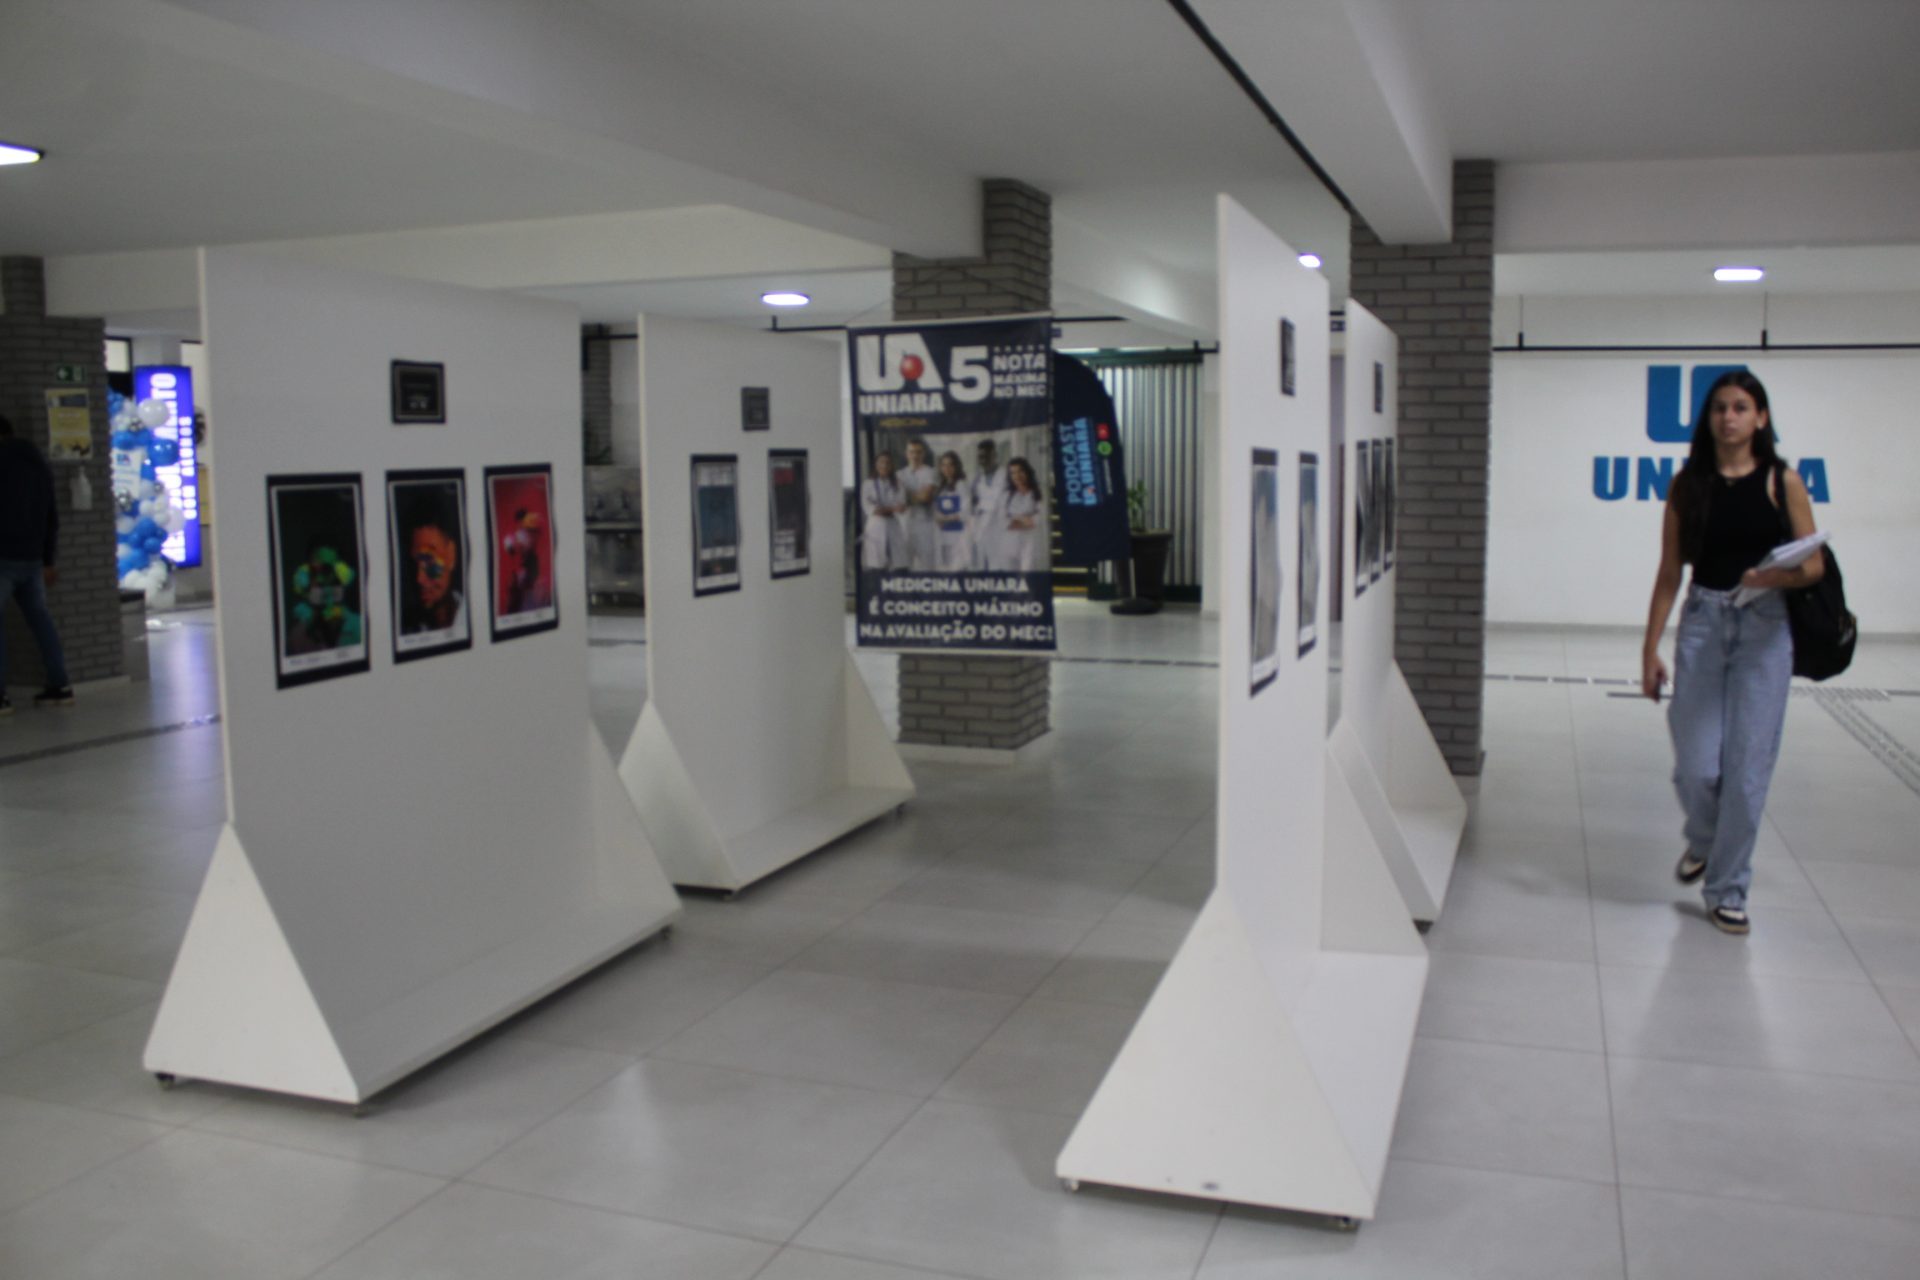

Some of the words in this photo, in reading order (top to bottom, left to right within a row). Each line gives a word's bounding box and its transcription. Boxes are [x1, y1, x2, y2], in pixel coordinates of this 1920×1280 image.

[856, 333, 944, 392] UA
[993, 353, 1046, 371] NOTA
[949, 346, 991, 403] 5
[993, 386, 1014, 398] NO
[1017, 384, 1046, 397] MEC
[859, 392, 945, 415] UNIARA
[1073, 417, 1094, 484] UNIARA
[1059, 422, 1082, 504] PODCAST
[881, 578, 960, 593] MEDICINA
[965, 578, 1029, 593] UNIARA
[869, 596, 879, 616] É
[883, 600, 970, 616] CONCEITO
[974, 597, 1044, 616] MÁXIMO
[860, 623, 883, 639] NA
[885, 620, 977, 642] AVALIAÇÃO
[981, 625, 1006, 640] DO
[1010, 626, 1053, 640] MEC!
